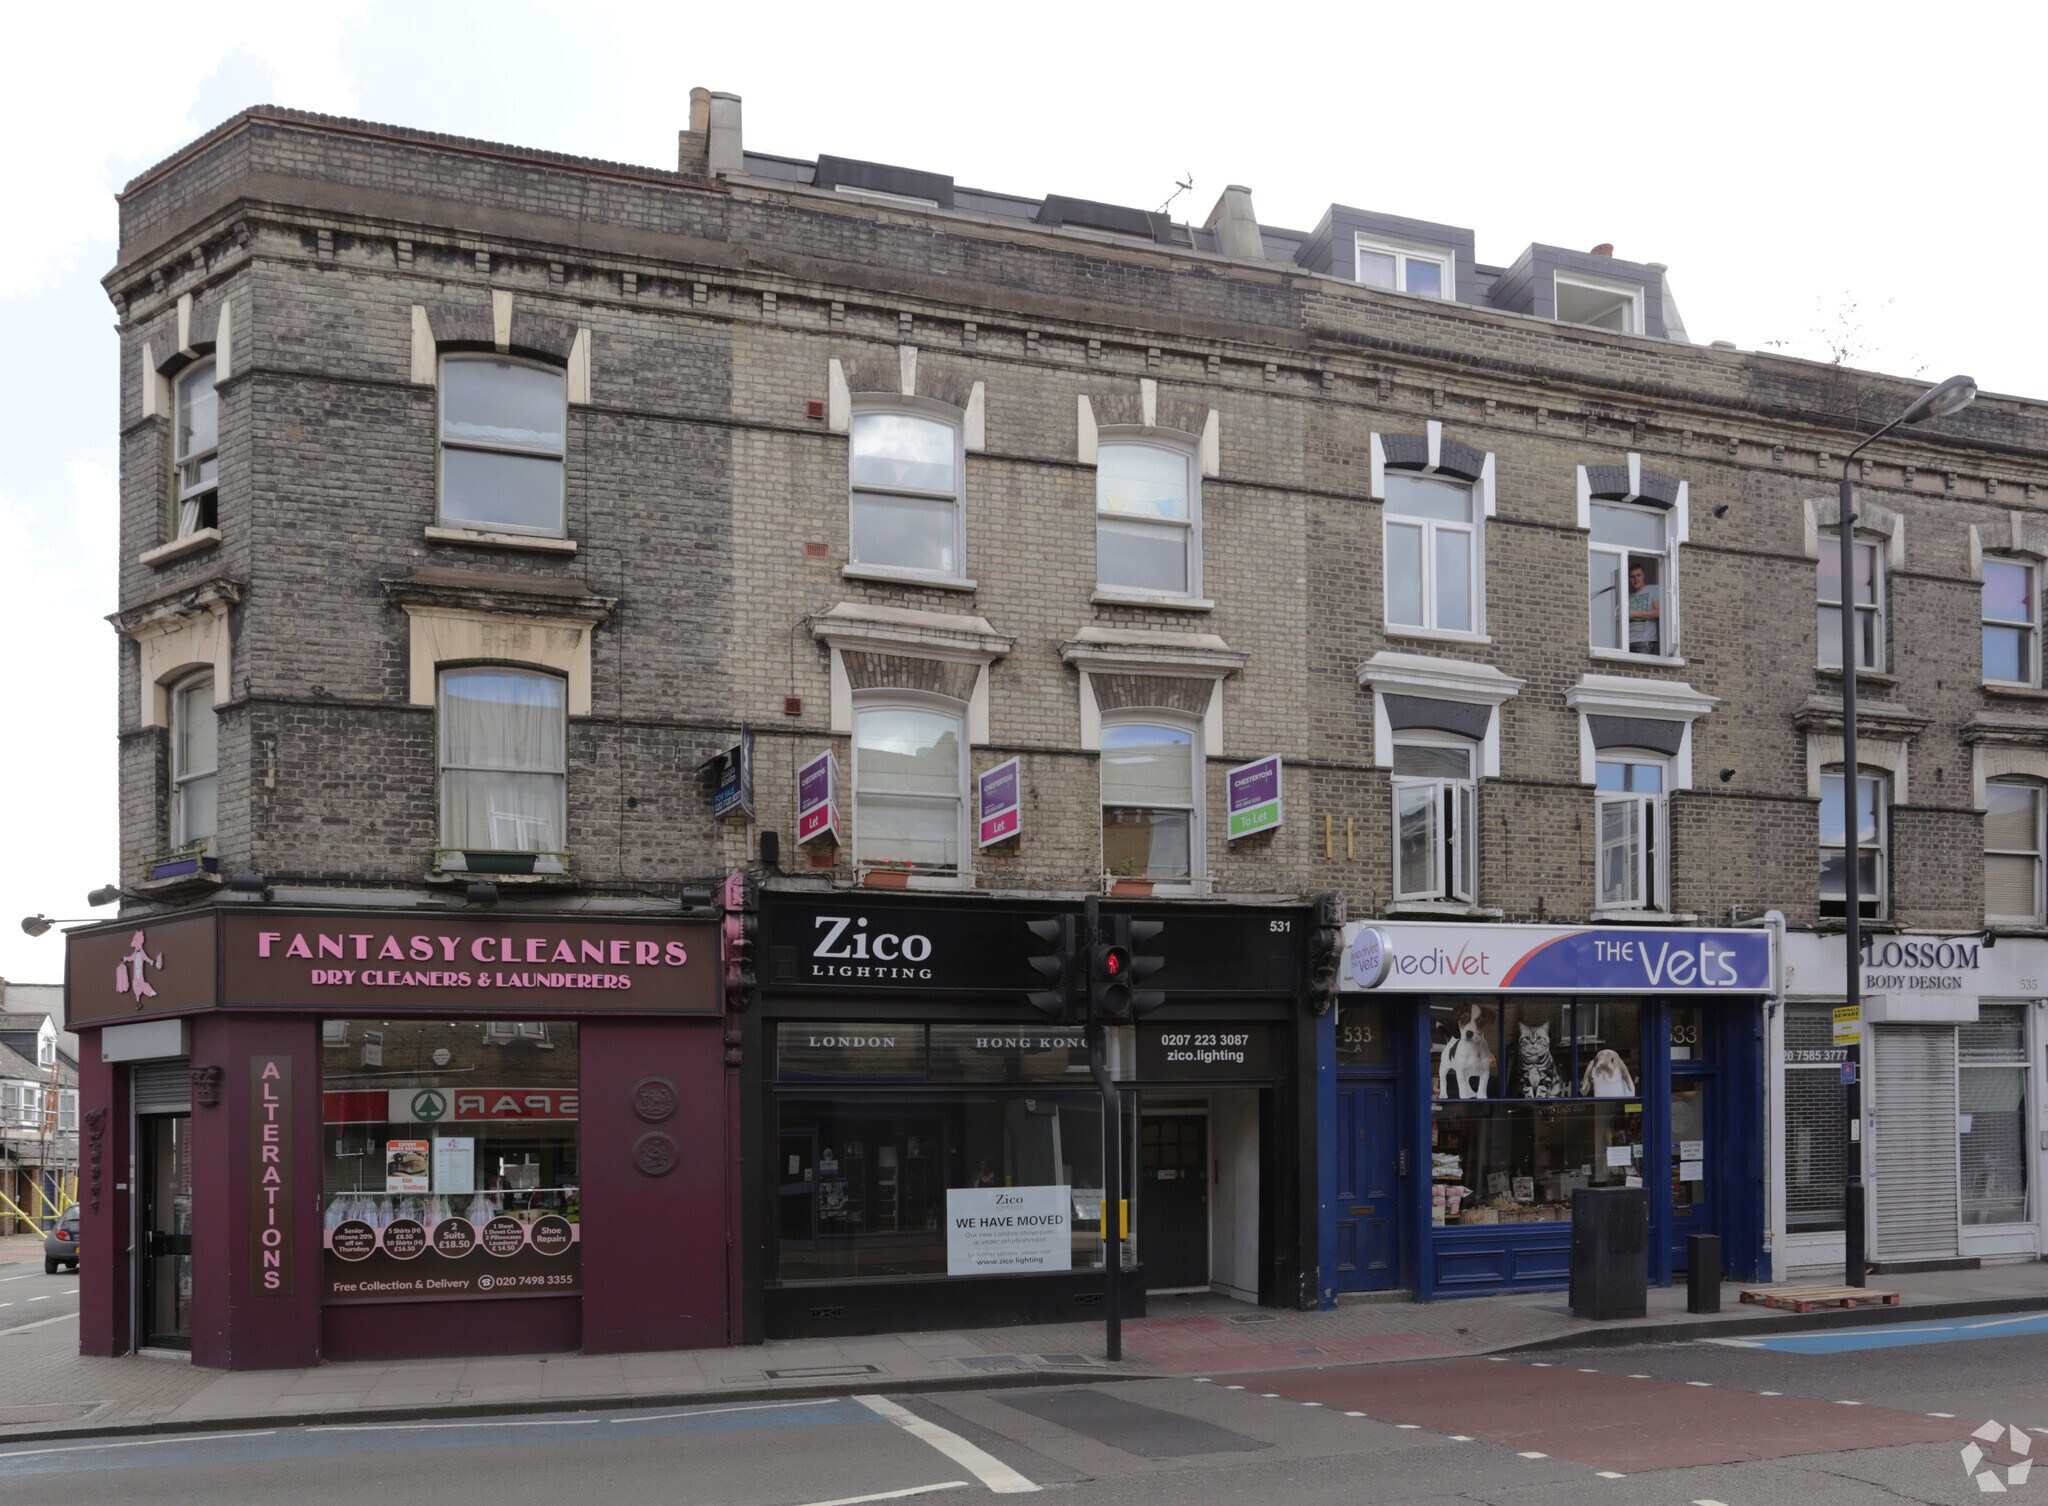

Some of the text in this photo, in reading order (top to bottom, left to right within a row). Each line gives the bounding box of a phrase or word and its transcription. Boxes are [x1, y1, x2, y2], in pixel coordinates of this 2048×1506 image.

[1234, 769, 1273, 788] CHESTERTONS
[809, 815, 819, 829] Let
[1240, 811, 1267, 827] To Let
[993, 820, 1005, 833] Let
[1269, 920, 1291, 932] 531
[813, 916, 932, 961] Zico
[258, 932, 687, 966] FANTASY CLEANERS
[1859, 942, 1980, 969] LOSSOM
[1359, 955, 1378, 971] Vets
[1594, 941, 1738, 986] THE Vets
[812, 965, 932, 979] LIGHTING
[311, 969, 632, 989] DRY CLEANERS & LAUNDERERS
[1866, 974, 1962, 989] BODY DESIGN
[2019, 979, 2038, 990] 535
[1161, 1034, 1249, 1046] 0207 223 3087
[1344, 1026, 1372, 1043] 533
[1670, 1025, 1697, 1043] 33
[809, 1036, 895, 1047] LONDON
[975, 1038, 1031, 1048] HONG
[1354, 1044, 1362, 1053] A
[1167, 1050, 1244, 1063] zico.lighting
[1797, 1050, 1821, 1061] 7585
[1824, 1050, 1848, 1061] 3777
[261, 1061, 281, 1290] ALTERATIONS
[995, 1194, 1024, 1205] Zico
[451, 1222, 458, 1231] 2
[956, 1215, 1063, 1229] WE HAVE MOVED
[443, 1231, 466, 1240] Suits
[541, 1227, 562, 1235] Shoe
[439, 1240, 470, 1249] £18.50
[536, 1235, 567, 1244] Repairs
[976, 1256, 1044, 1265] www.zico.lighting
[333, 1278, 470, 1292] Free Collection & Delivery
[495, 1275, 573, 1286] 020 7498 3355
